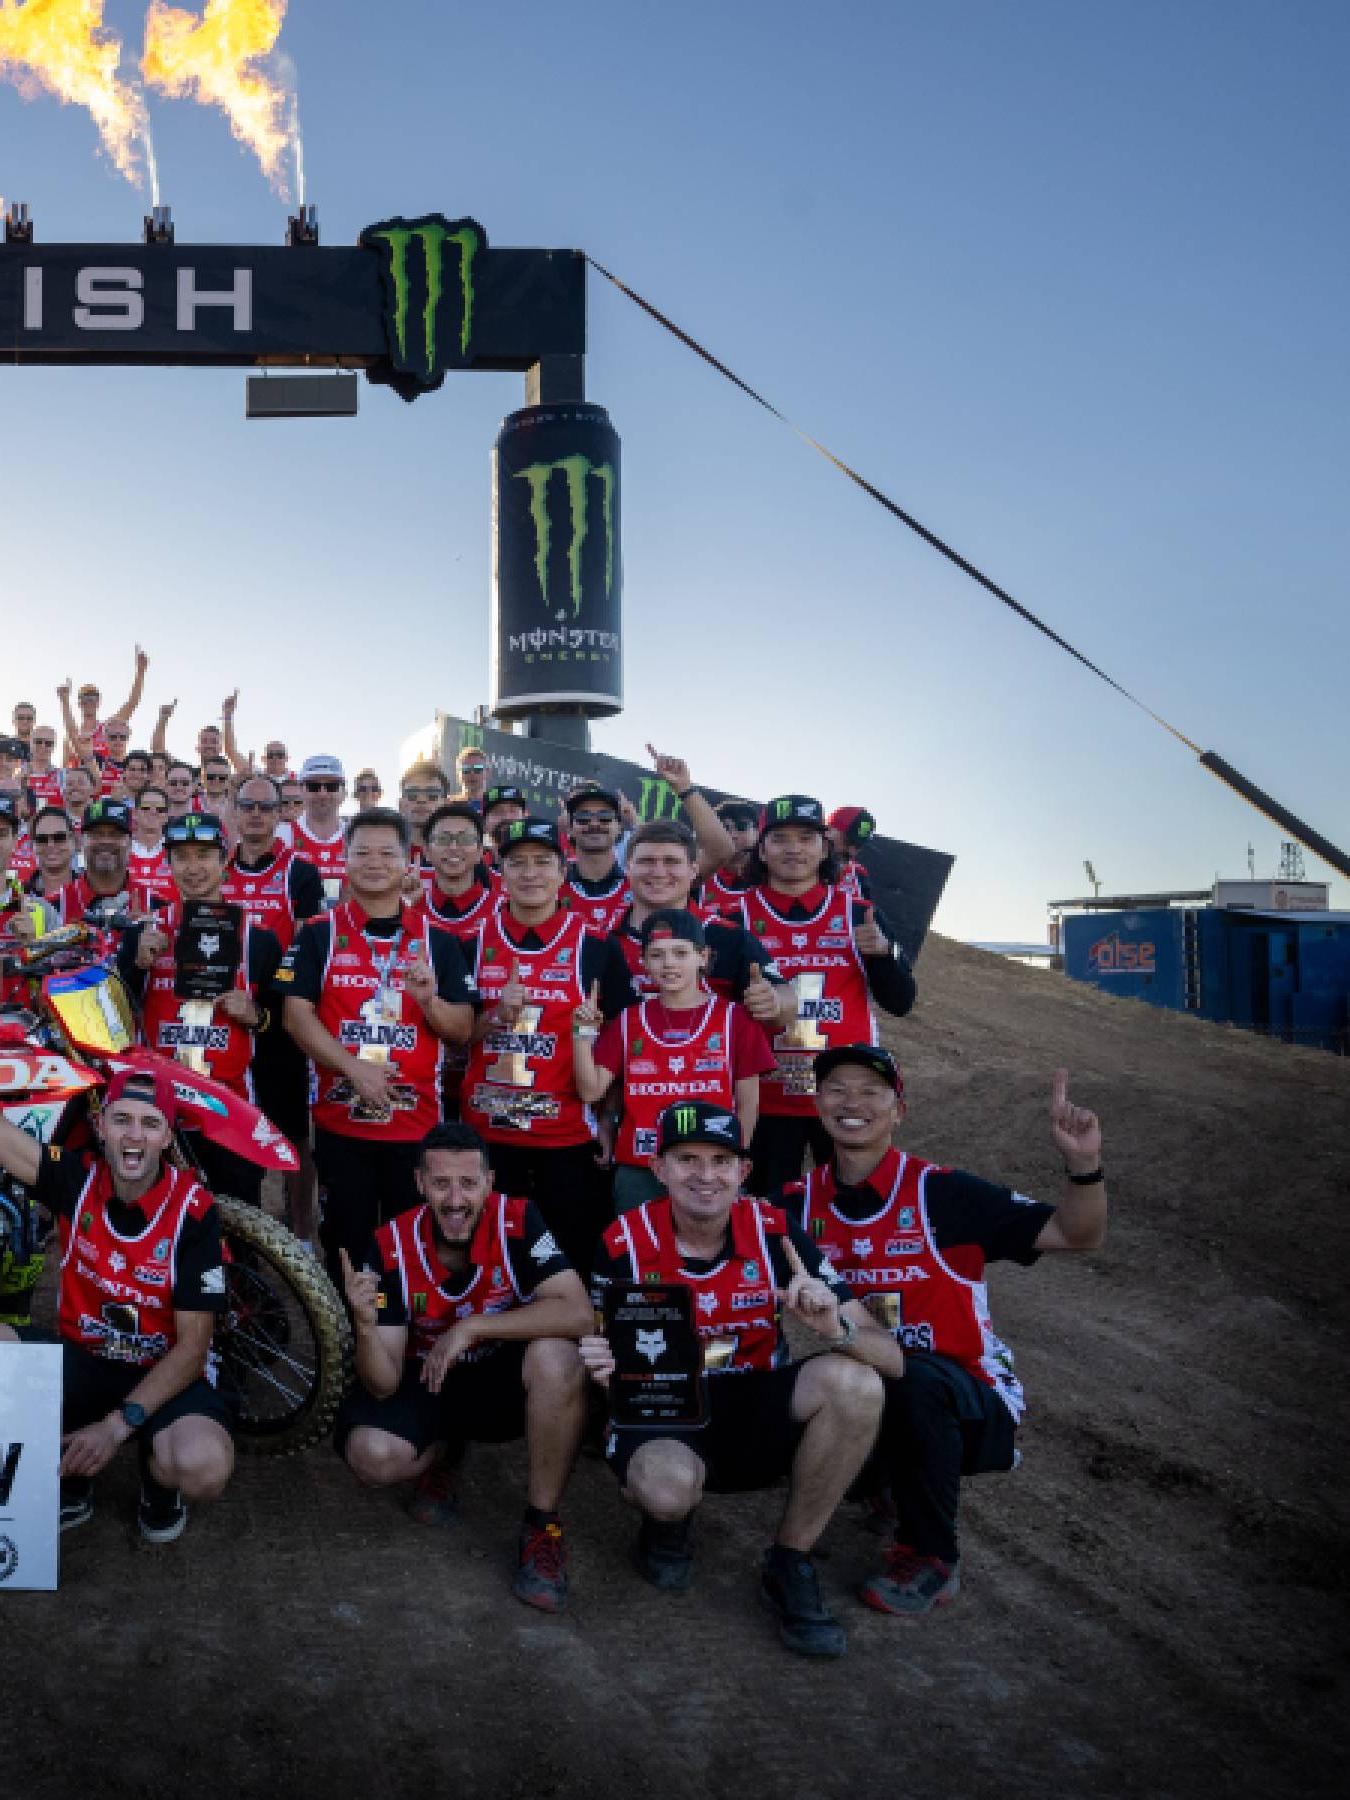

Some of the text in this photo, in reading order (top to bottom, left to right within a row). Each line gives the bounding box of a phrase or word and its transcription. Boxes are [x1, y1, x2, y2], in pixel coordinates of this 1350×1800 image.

[774, 956, 850, 968] ONDA
[482, 986, 570, 1002] HDA
[342, 1022, 416, 1050] HERLINGS
[627, 1079, 723, 1096] HONDA
[840, 1265, 930, 1283] ONDA
